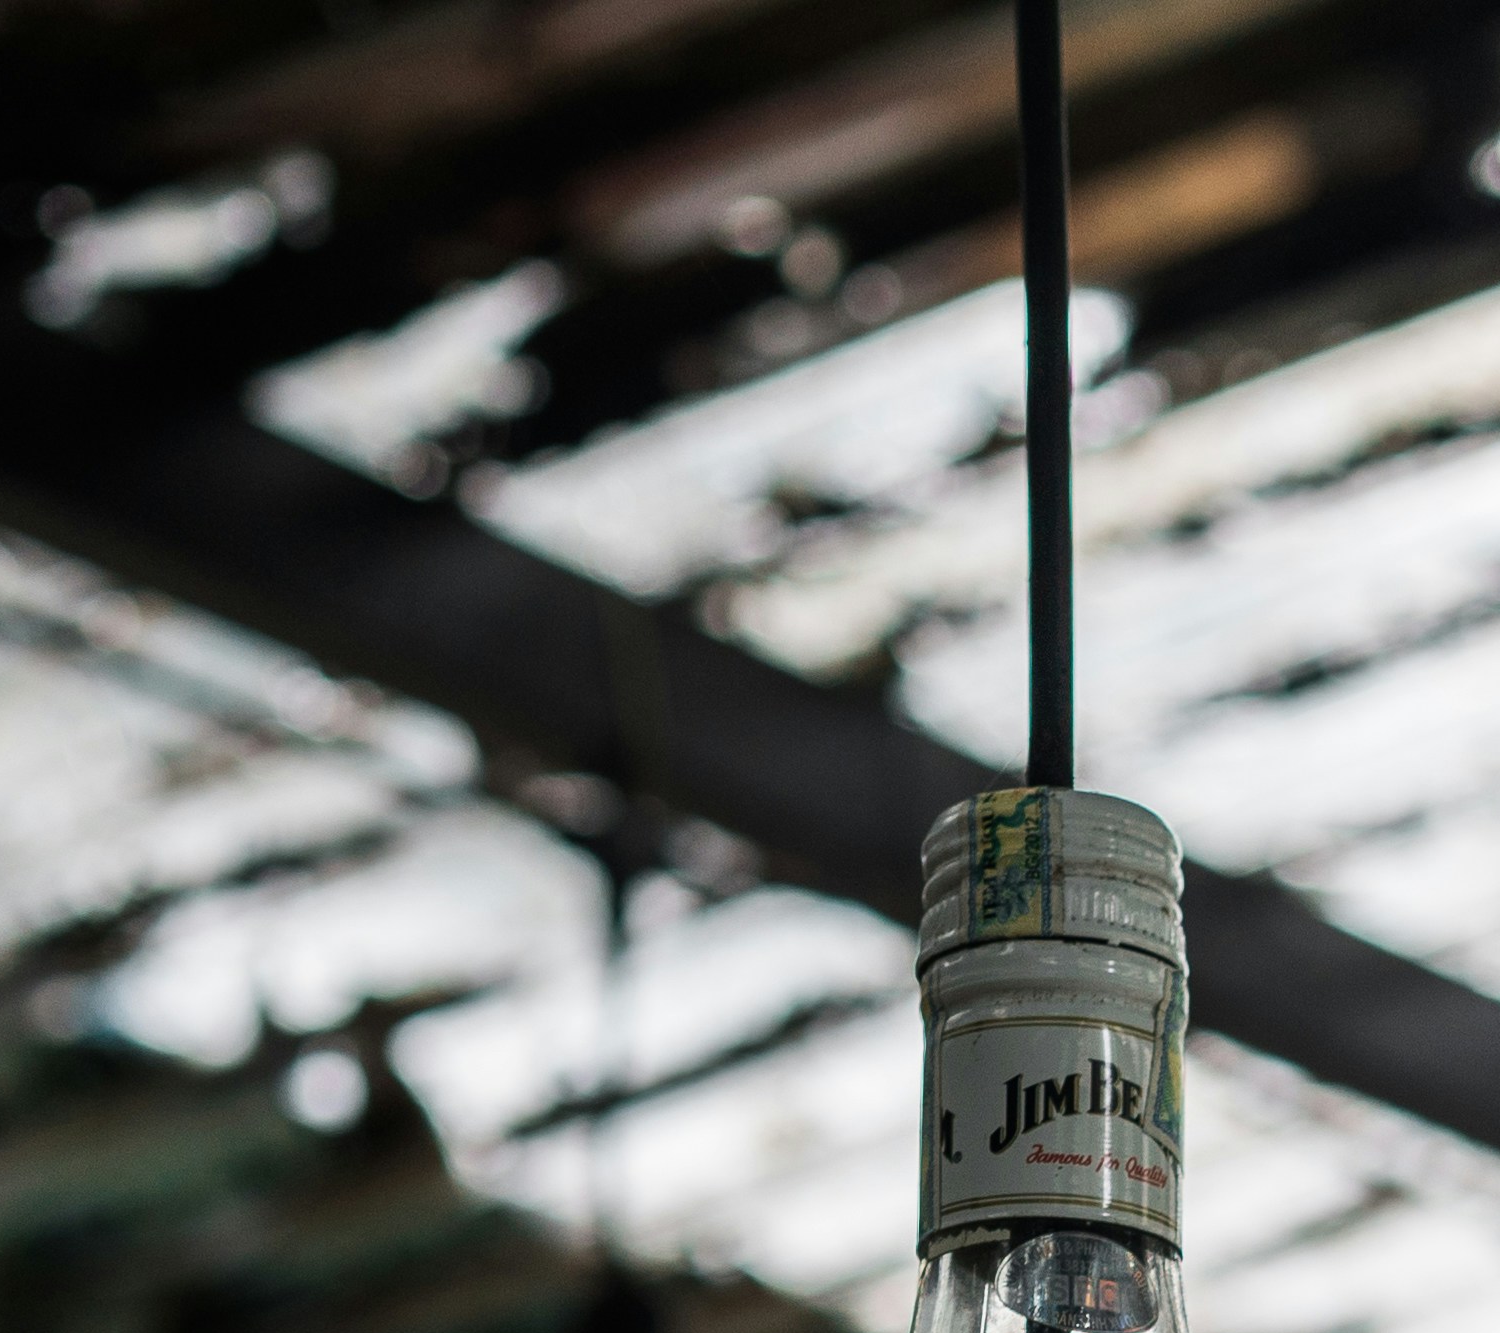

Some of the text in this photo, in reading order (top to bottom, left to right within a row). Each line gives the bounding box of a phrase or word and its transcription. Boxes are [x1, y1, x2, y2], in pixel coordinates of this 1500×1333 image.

[989, 1072, 1082, 1155] JIM
[1086, 1058, 1145, 1128] BE
[1026, 1144, 1092, 1167] Famous
